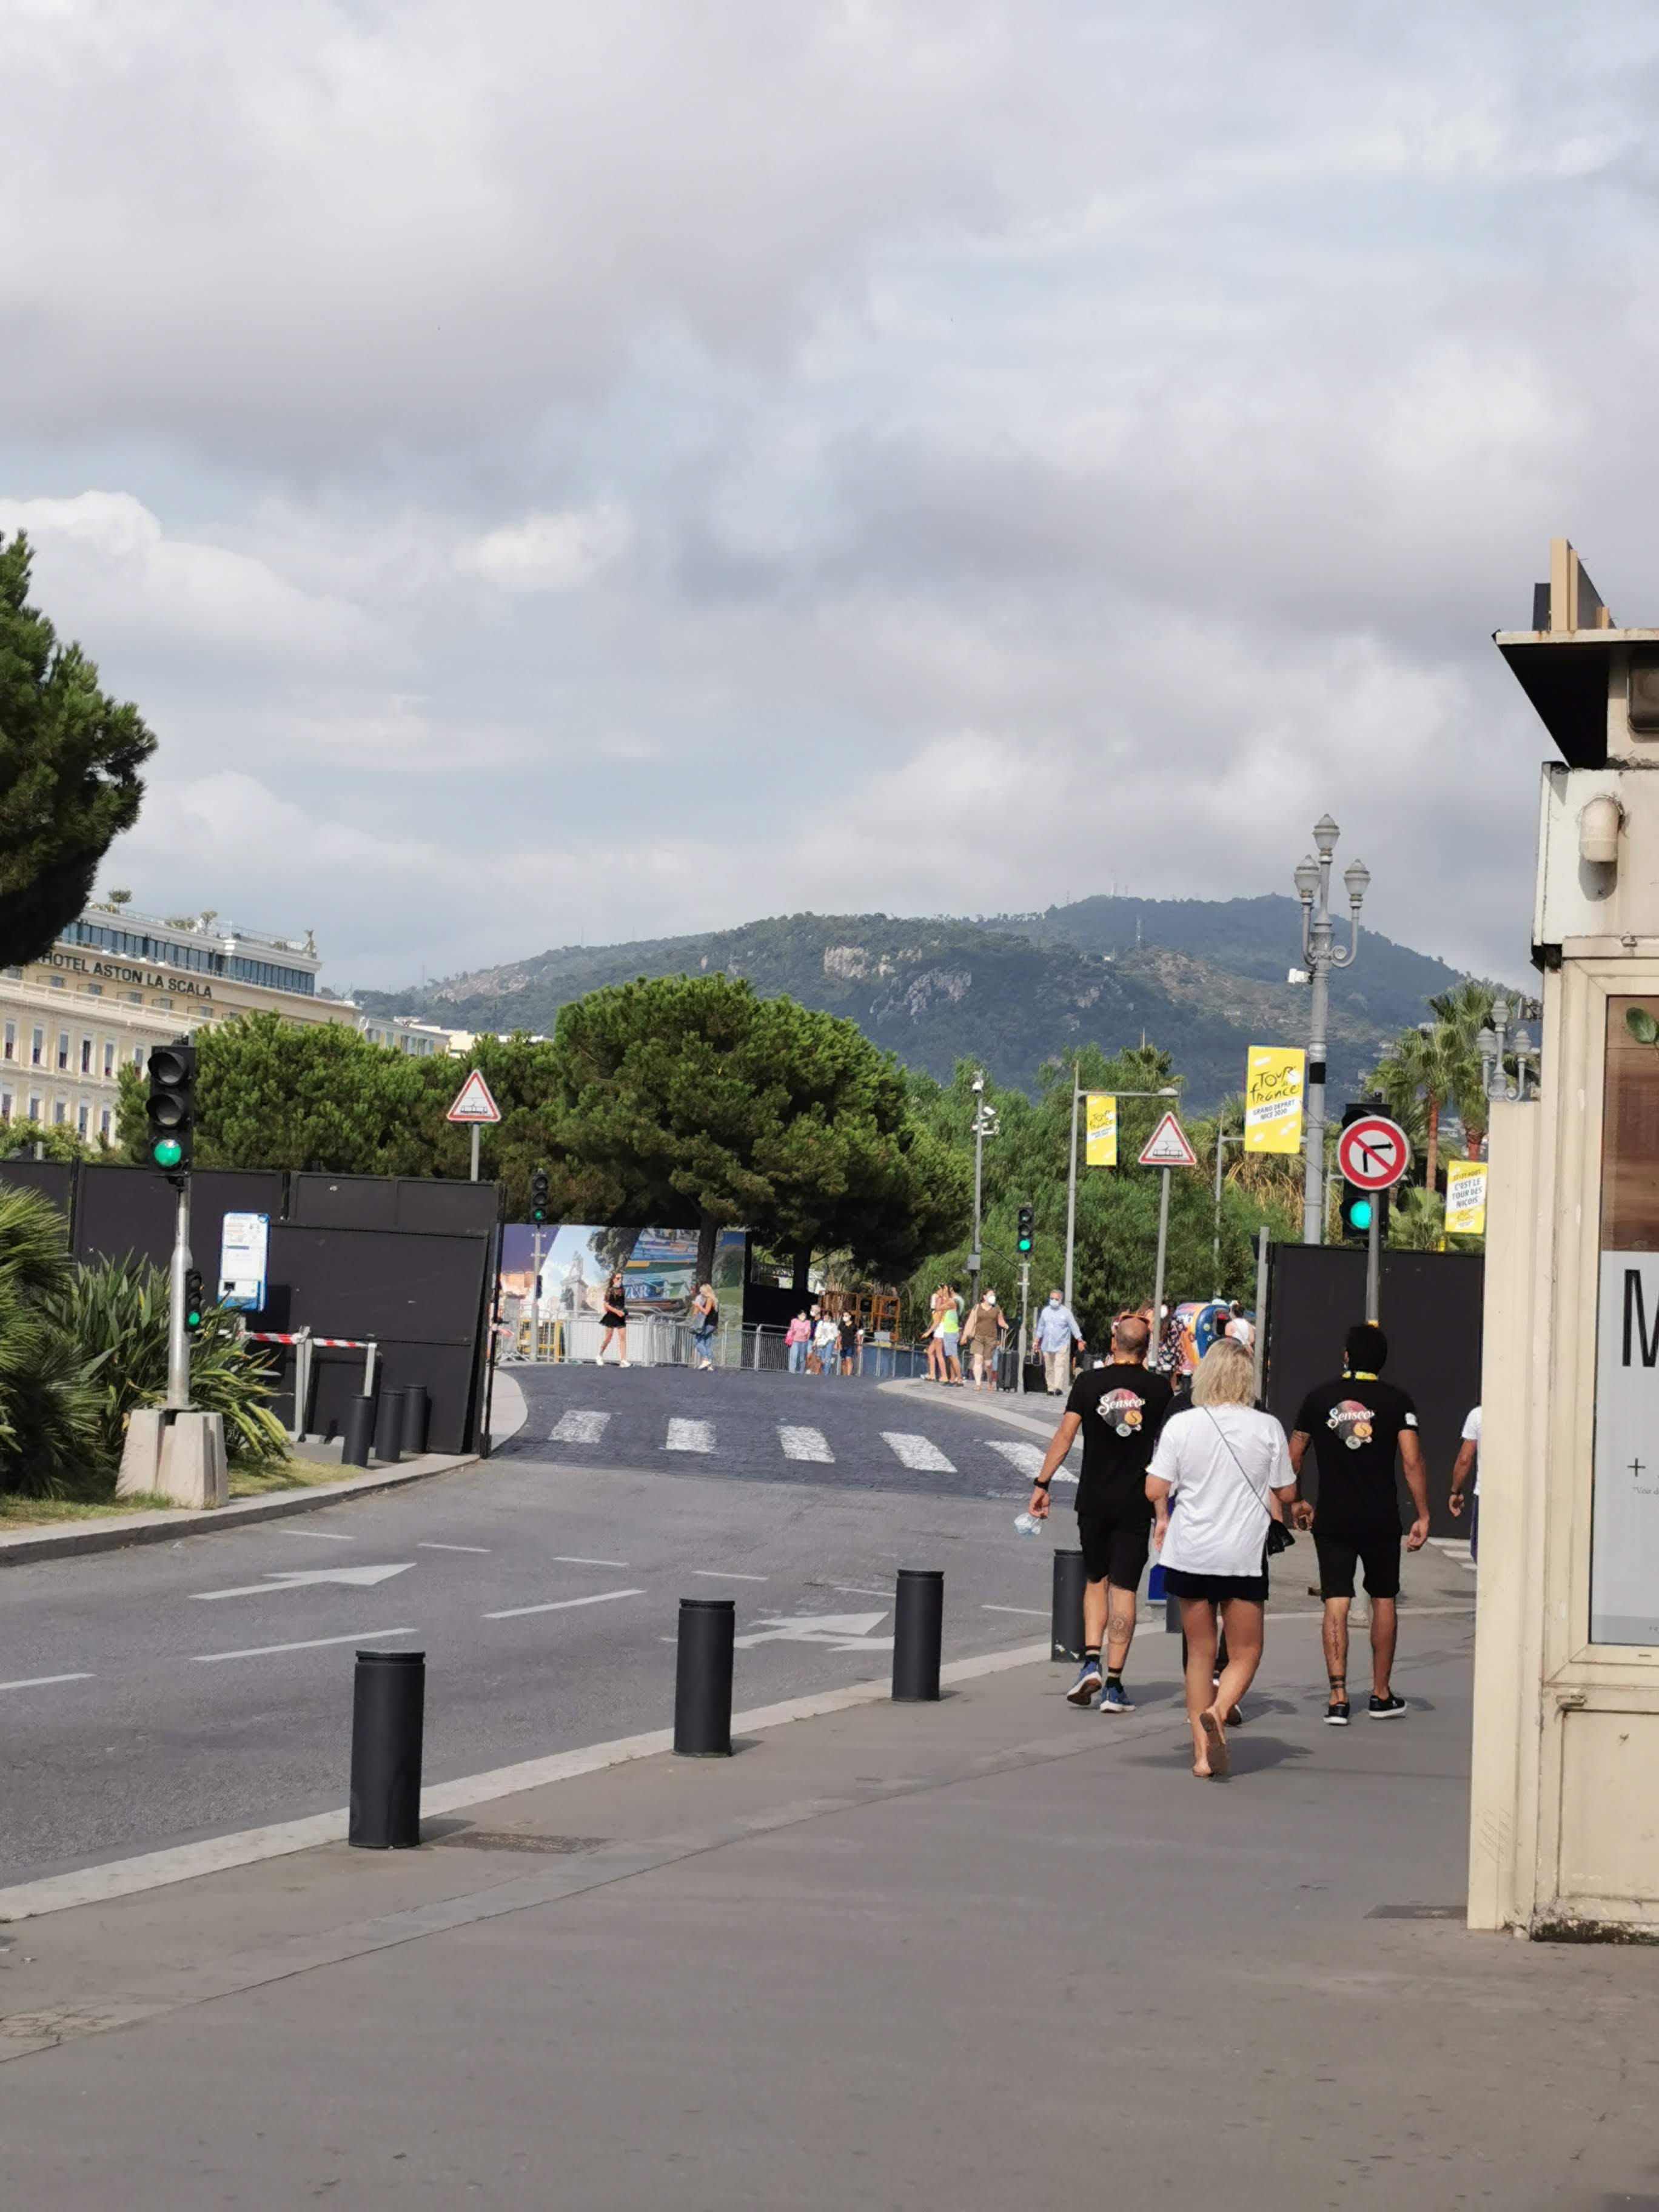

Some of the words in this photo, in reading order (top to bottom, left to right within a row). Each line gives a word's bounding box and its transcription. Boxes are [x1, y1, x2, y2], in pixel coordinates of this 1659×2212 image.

[42, 951, 90, 973] HOTEL
[93, 962, 142, 984] ASTON
[147, 973, 164, 988] LA
[168, 977, 212, 999] SCALA
[1253, 1105, 1273, 1116] GRAND
[1261, 1111, 1273, 1121] NICE
[1274, 1108, 1287, 1116] 2020
[1454, 1179, 1472, 1190] C'EST
[1473, 1178, 1481, 1187] LE
[1452, 1190, 1469, 1200] TOUR
[1470, 1186, 1482, 1196] DES
